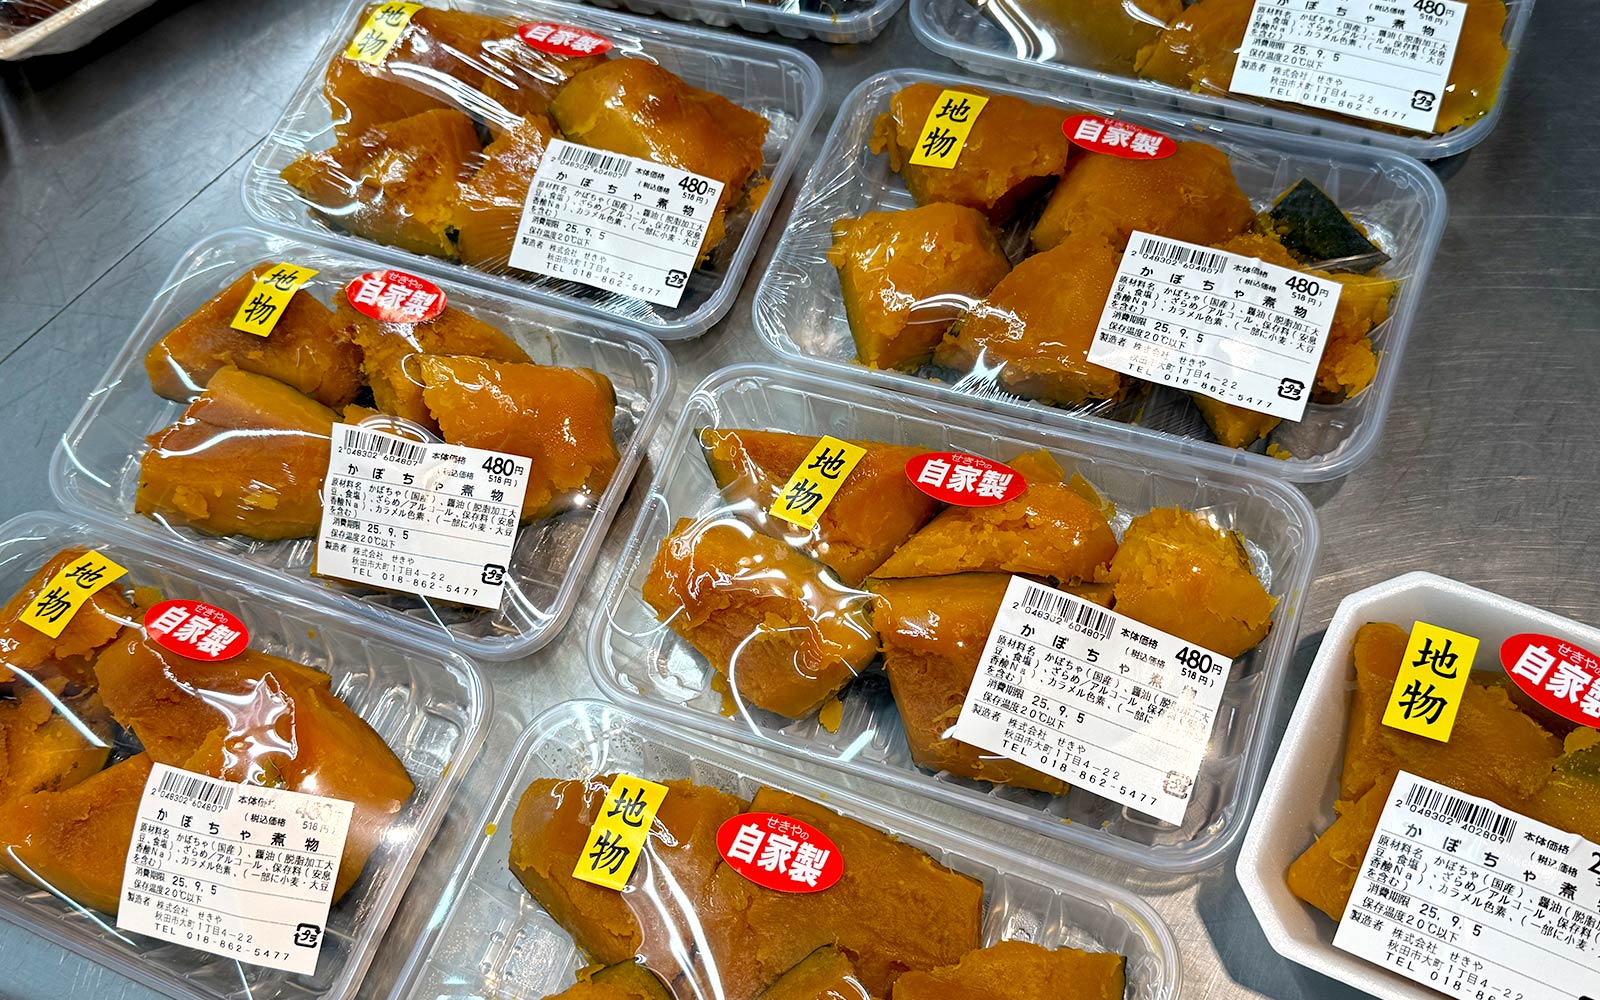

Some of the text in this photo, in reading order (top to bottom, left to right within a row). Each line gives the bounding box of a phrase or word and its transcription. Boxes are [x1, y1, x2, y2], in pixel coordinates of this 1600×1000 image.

[357, 5, 408, 56] 地物
[525, 24, 605, 54] 自家製
[1268, 85, 1293, 97] TEL
[922, 98, 971, 158] 地物
[1074, 119, 1164, 156] 自家製
[545, 261, 565, 272] TEL
[1118, 275, 1156, 290] 原材料名
[244, 268, 298, 325] 地物
[354, 278, 439, 318] 自家製
[1111, 310, 1147, 326] 消費期限
[1098, 333, 1206, 369] 製造者 せきや
[1126, 363, 1153, 375] TEL
[951, 453, 993, 469] せきやの
[785, 446, 846, 515] 地物
[917, 458, 1014, 500] 自家製
[325, 541, 415, 566] 製造者 株式会社 せきや
[351, 566, 372, 577] TEL
[34, 561, 107, 623] 地物
[194, 603, 228, 624] せきやの
[150, 605, 241, 658] 自家製
[1119, 629, 1158, 648] 本体価格
[996, 634, 1037, 656] 原材料名
[986, 678, 1024, 699] 消費期限
[1398, 637, 1460, 725] 地物
[971, 704, 1087, 754] 製造者 株式会社 せきや
[1000, 740, 1029, 755] TEL
[140, 823, 170, 837] 原材料名
[589, 787, 648, 875] 地物
[767, 816, 810, 840] せきやの
[1394, 798, 1504, 844] 2 048302 402809
[1377, 834, 1424, 859] 原材料名
[1523, 830, 1569, 855] 本体価格
[727, 823, 831, 888] 自家製
[1366, 882, 1411, 907] 消費期限
[126, 893, 222, 923] 製造者 株式会社 せきや
[1361, 897, 1459, 943] 保存温度20℃以下
[154, 923, 177, 934] TEL
[1348, 910, 1484, 972] 製造者 株式会社 せきや
[1383, 952, 1416, 971] TEL
